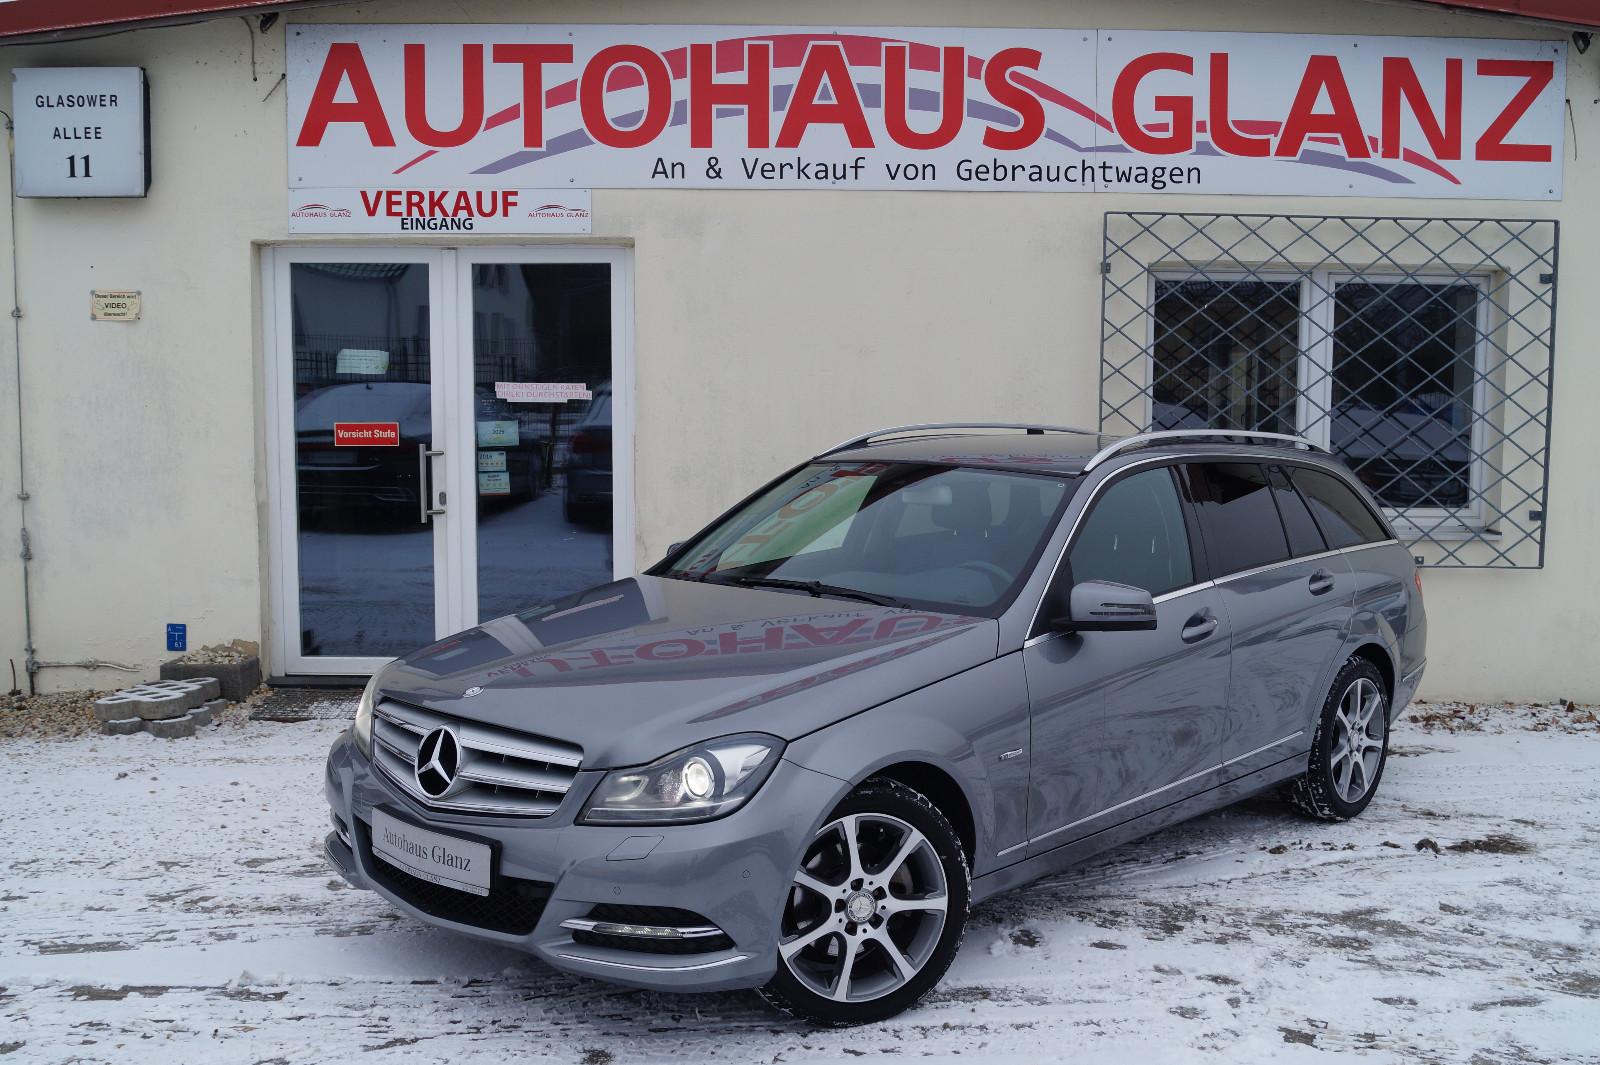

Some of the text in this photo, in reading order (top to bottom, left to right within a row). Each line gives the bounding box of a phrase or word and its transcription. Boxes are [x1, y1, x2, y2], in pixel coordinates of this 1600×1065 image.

[35, 94, 118, 108] GLASOWER
[295, 42, 1554, 162] AUTOHAUS GLANZ
[53, 127, 103, 140] ALLEE
[66, 154, 93, 178] 11
[651, 156, 1201, 190] An & Verkauf von Gebrauchtwagen
[360, 190, 519, 218] VERKAUF
[401, 218, 474, 231] EINGANG
[337, 429, 396, 438] Vorsicht Stufe
[383, 826, 428, 860] Autohaus
[431, 845, 471, 872] Glanz
